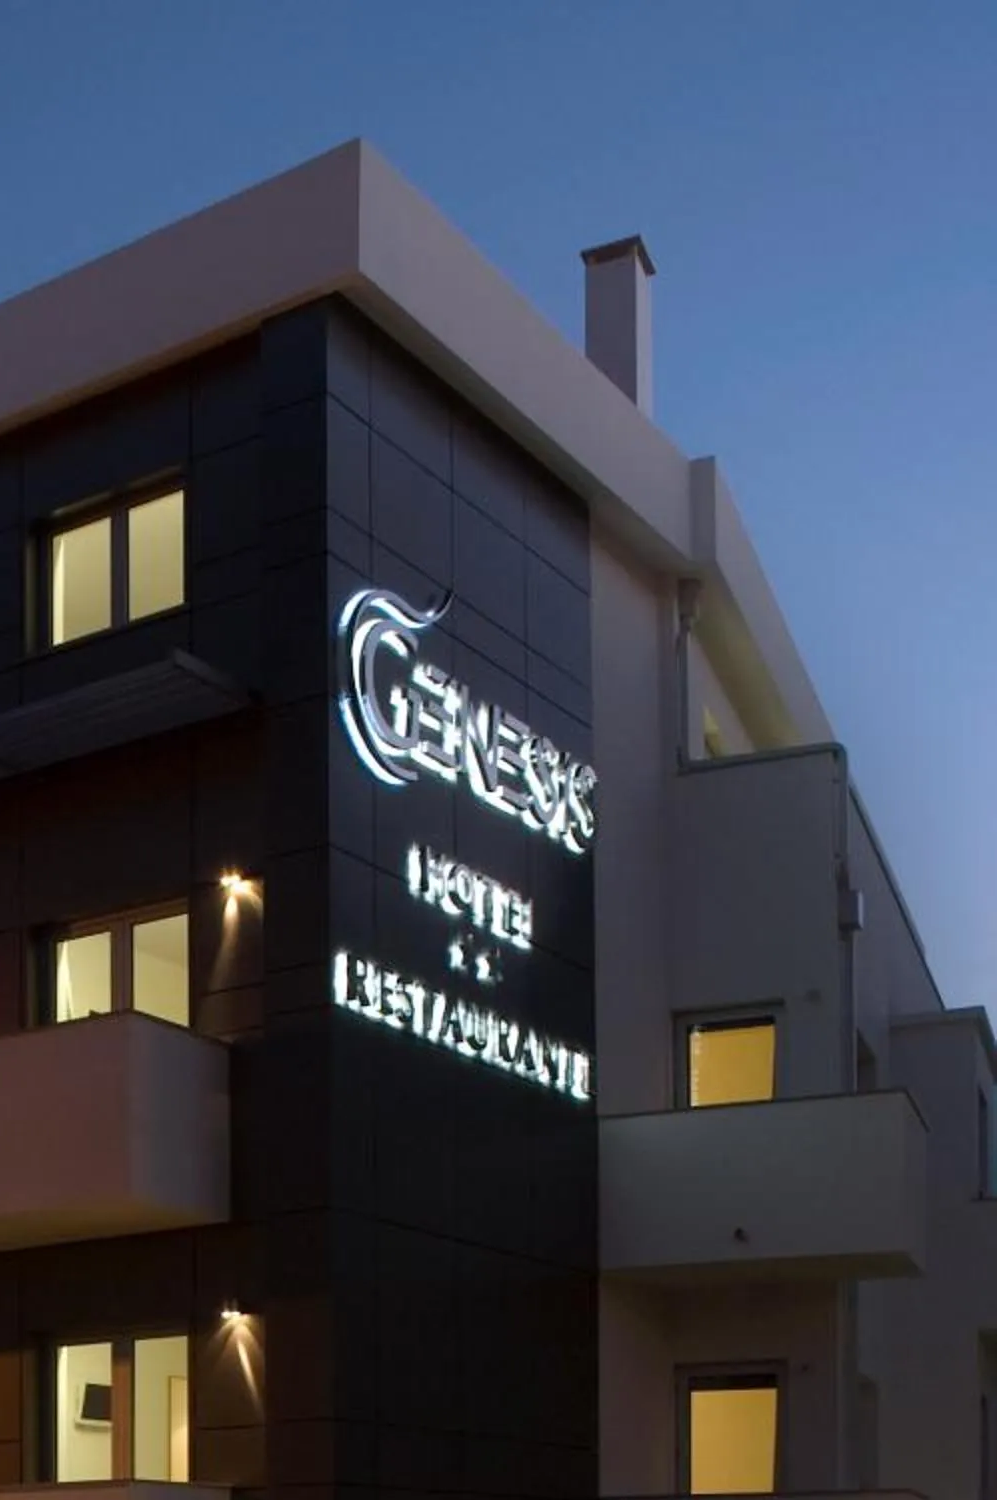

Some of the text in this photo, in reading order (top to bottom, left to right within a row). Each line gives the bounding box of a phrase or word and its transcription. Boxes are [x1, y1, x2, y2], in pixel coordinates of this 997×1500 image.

[338, 589, 596, 854] GENESIS
[407, 843, 534, 949] HOTEL
[332, 949, 593, 1101] RESTAURANTE
